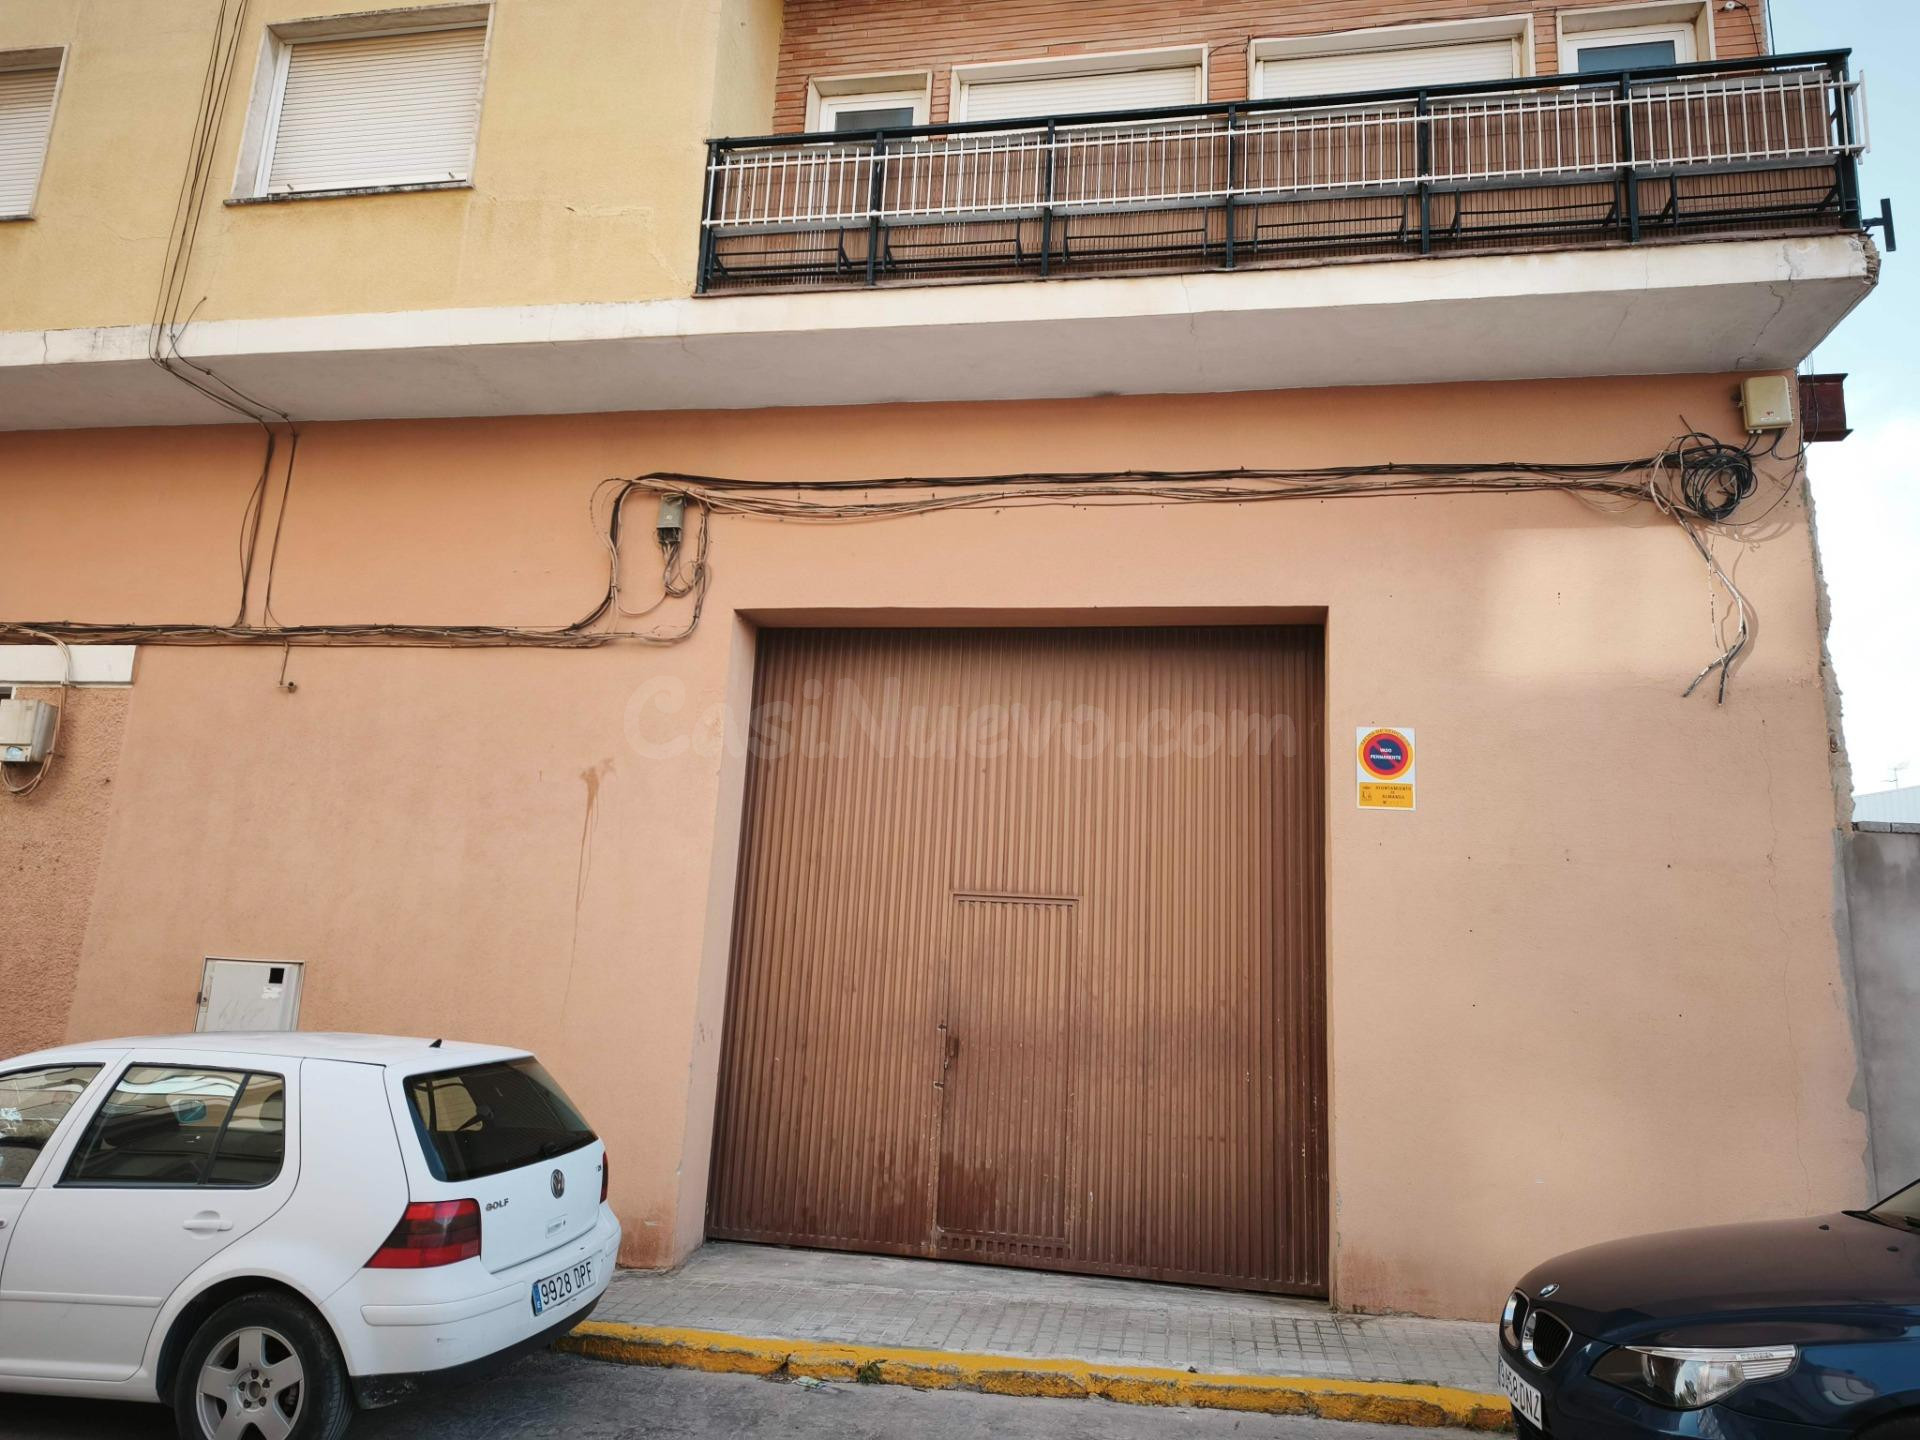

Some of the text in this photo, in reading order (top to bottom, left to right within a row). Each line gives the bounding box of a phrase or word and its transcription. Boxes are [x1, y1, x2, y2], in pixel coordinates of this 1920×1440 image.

[485, 1198, 509, 1211] GOLF
[541, 1272, 572, 1305] 9928
[573, 1261, 591, 1288] DPF
[1519, 1381, 1540, 1422] DNZ
